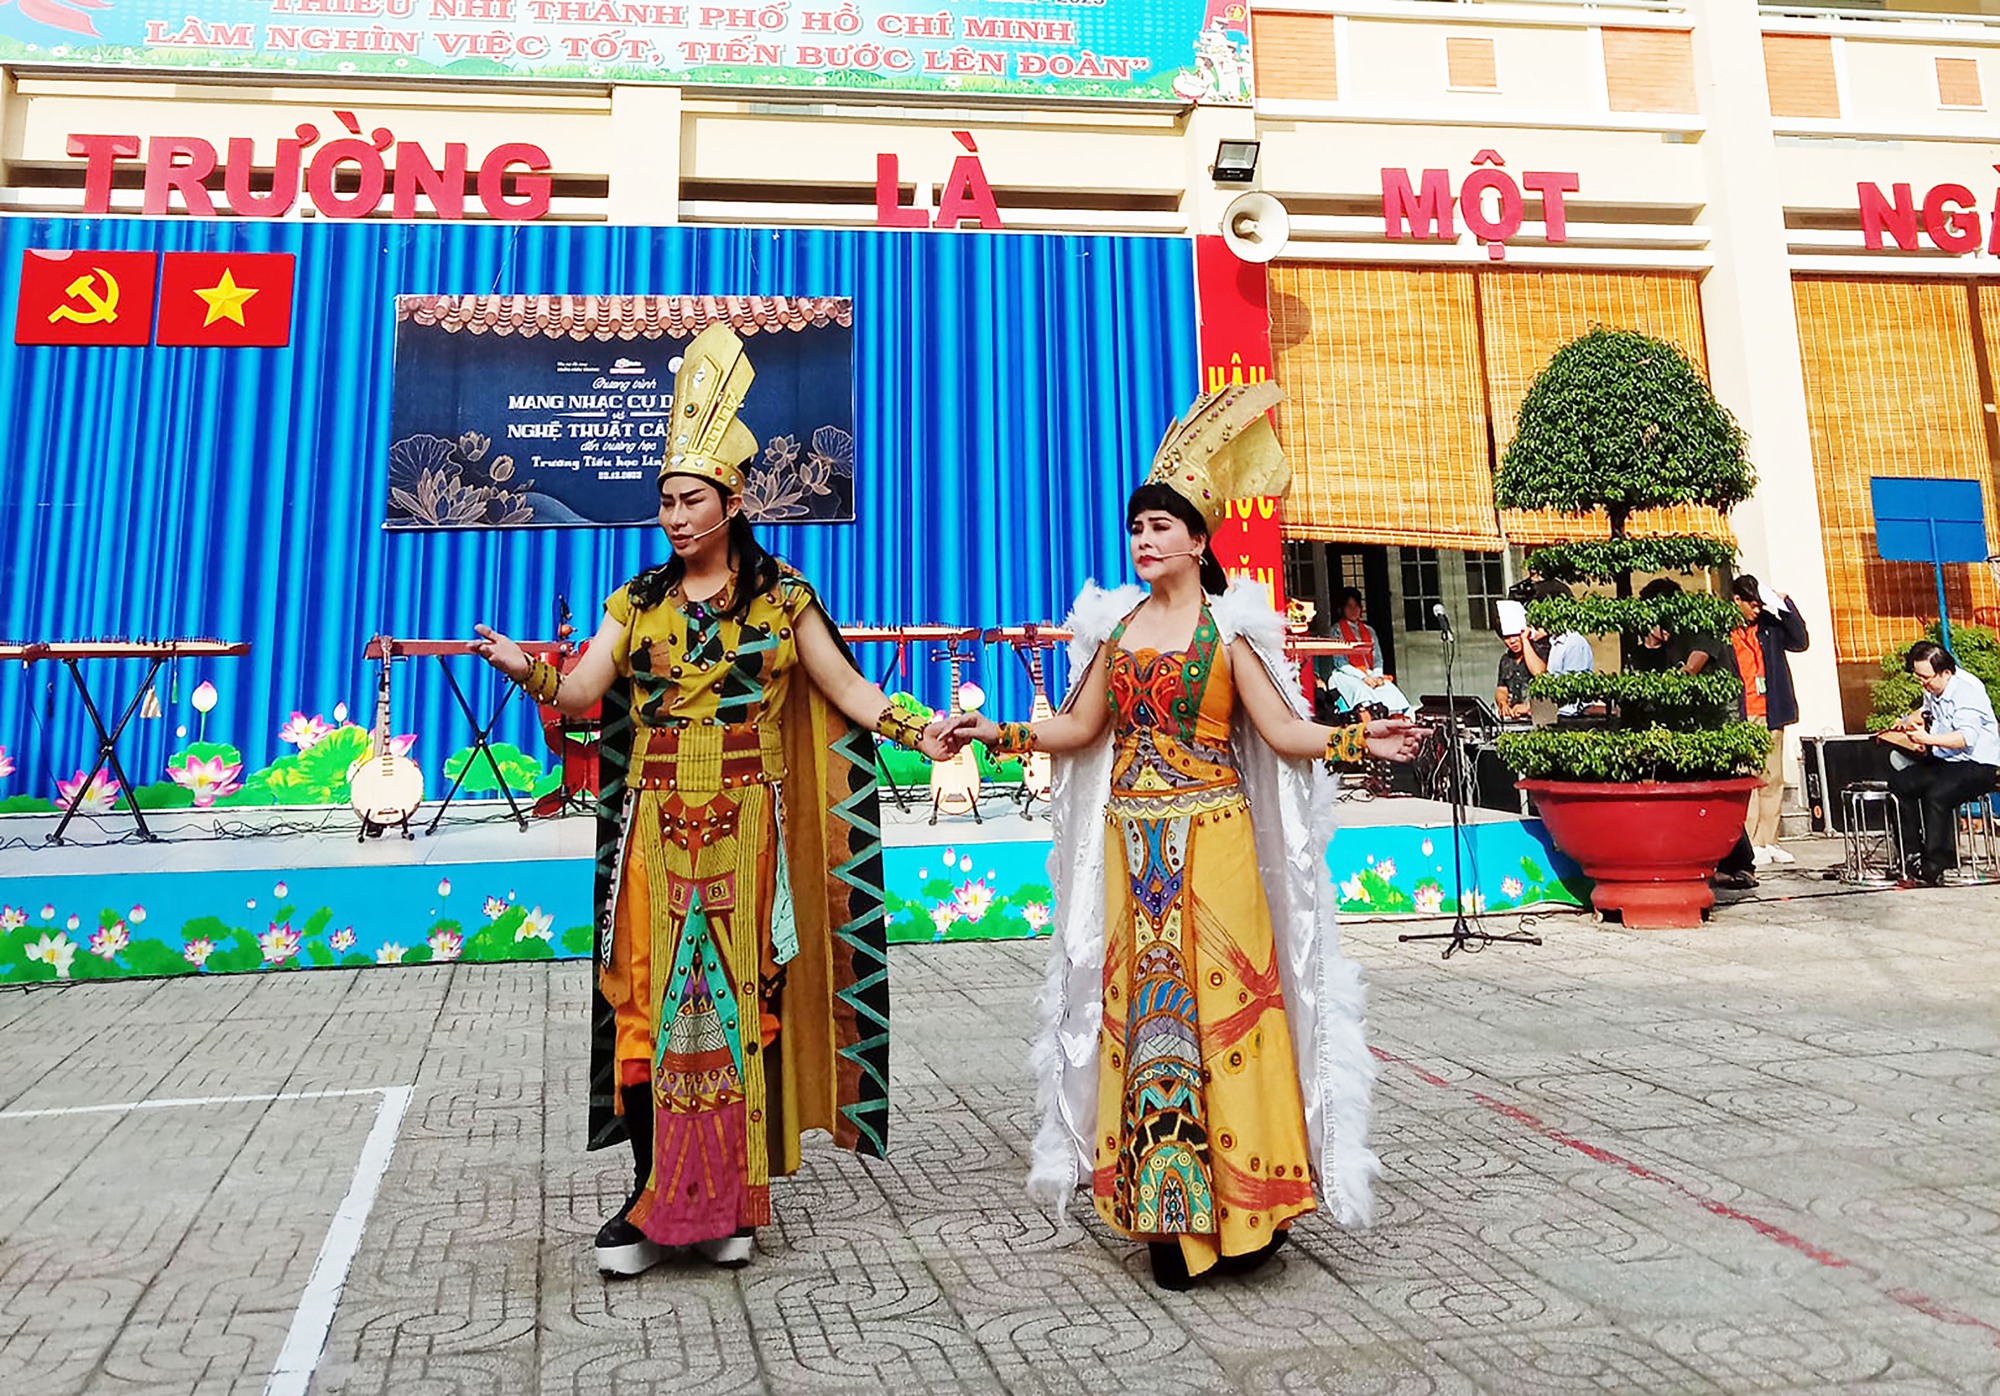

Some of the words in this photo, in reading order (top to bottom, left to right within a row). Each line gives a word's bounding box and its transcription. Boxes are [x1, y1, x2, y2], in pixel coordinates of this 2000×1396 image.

[700, 1, 787, 29] PHỐ
[801, 3, 860, 32] HỒ
[877, 12, 951, 36] CHÍ
[965, 18, 1073, 41] MINH
[146, 18, 252, 46] LÀM
[267, 25, 420, 52] NGHÌN
[433, 30, 544, 59] VIỆC
[561, 29, 661, 62] TỐT,
[678, 35, 782, 64] TIẾN
[796, 43, 910, 69] BƯỚC
[924, 48, 1005, 74] LÊN
[67, 110, 552, 220] TRƯỜNG
[876, 131, 1004, 229] LÀ
[1380, 149, 1580, 260] MỘT
[1857, 164, 2000, 256] NG
[508, 395, 564, 409] MANG
[569, 395, 623, 412] NHẠC
[628, 395, 656, 412] CỤ
[507, 421, 562, 441] NGHỆ
[567, 421, 634, 441] THUẬT
[616, 455, 639, 468] học
